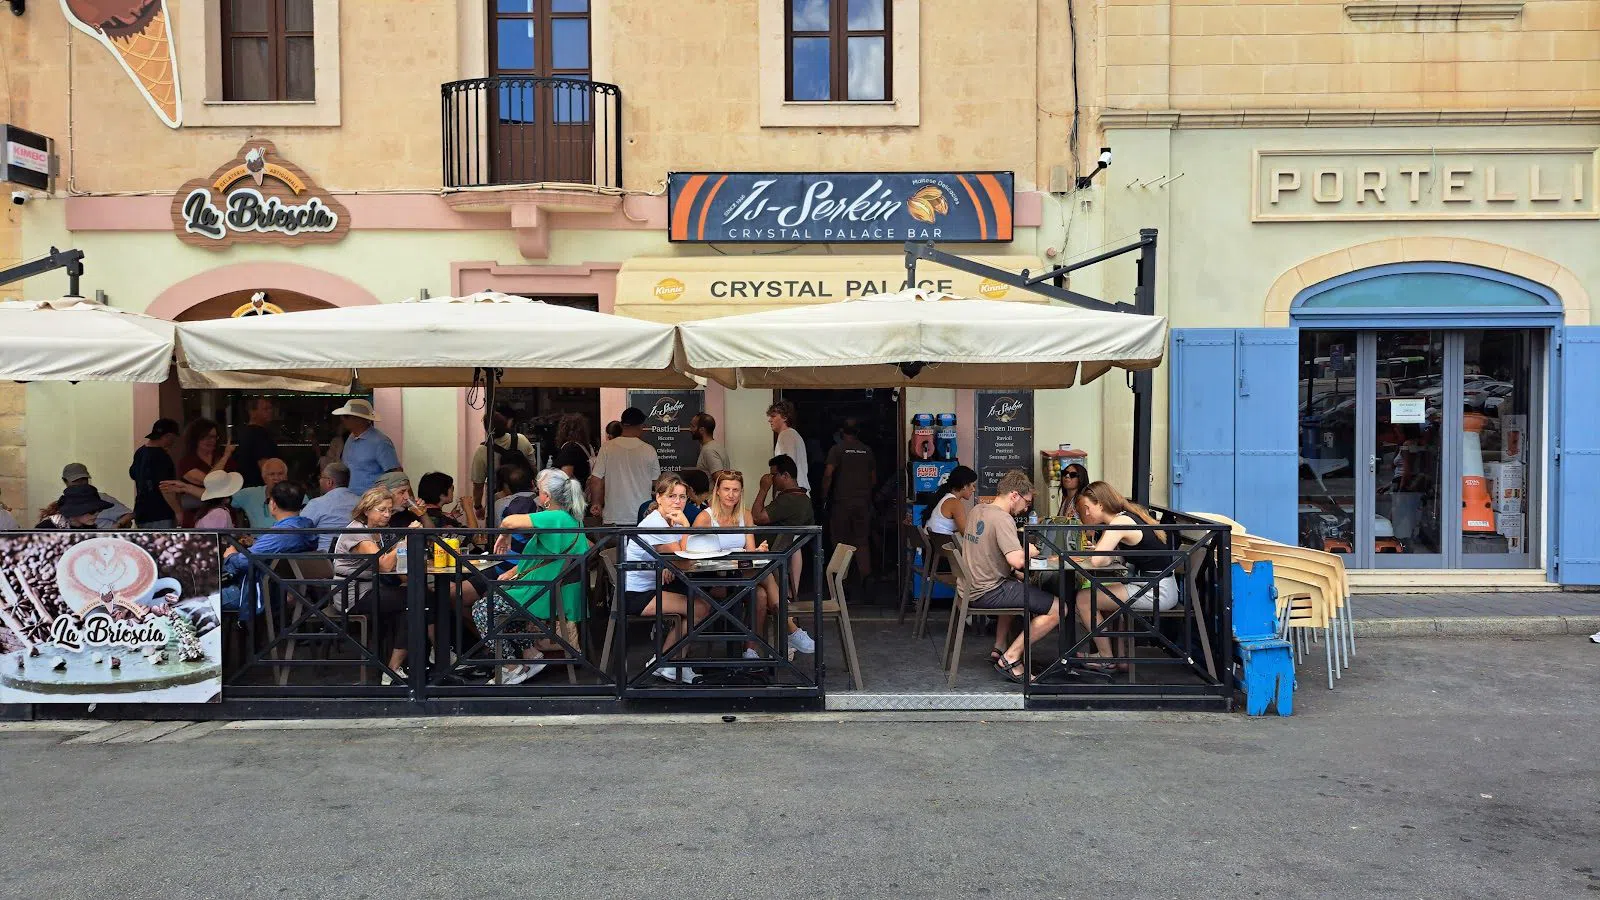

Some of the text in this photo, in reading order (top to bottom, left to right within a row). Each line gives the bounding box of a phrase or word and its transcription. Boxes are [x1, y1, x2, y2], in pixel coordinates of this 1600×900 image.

[13, 145, 46, 162] KIMBO
[219, 167, 299, 190] GELATERIA ARTIGIANALE
[1270, 164, 1584, 204] PORTELLI
[912, 178, 960, 205] Maltese Delicacies
[183, 192, 334, 235] La Brioscia
[728, 228, 943, 239] CRYSTAL PALACE BAR
[655, 284, 683, 296] Kinnie
[710, 280, 833, 298] CRYSTAL
[980, 282, 1010, 292] Kinnie
[53, 616, 166, 650] La Brioscia
